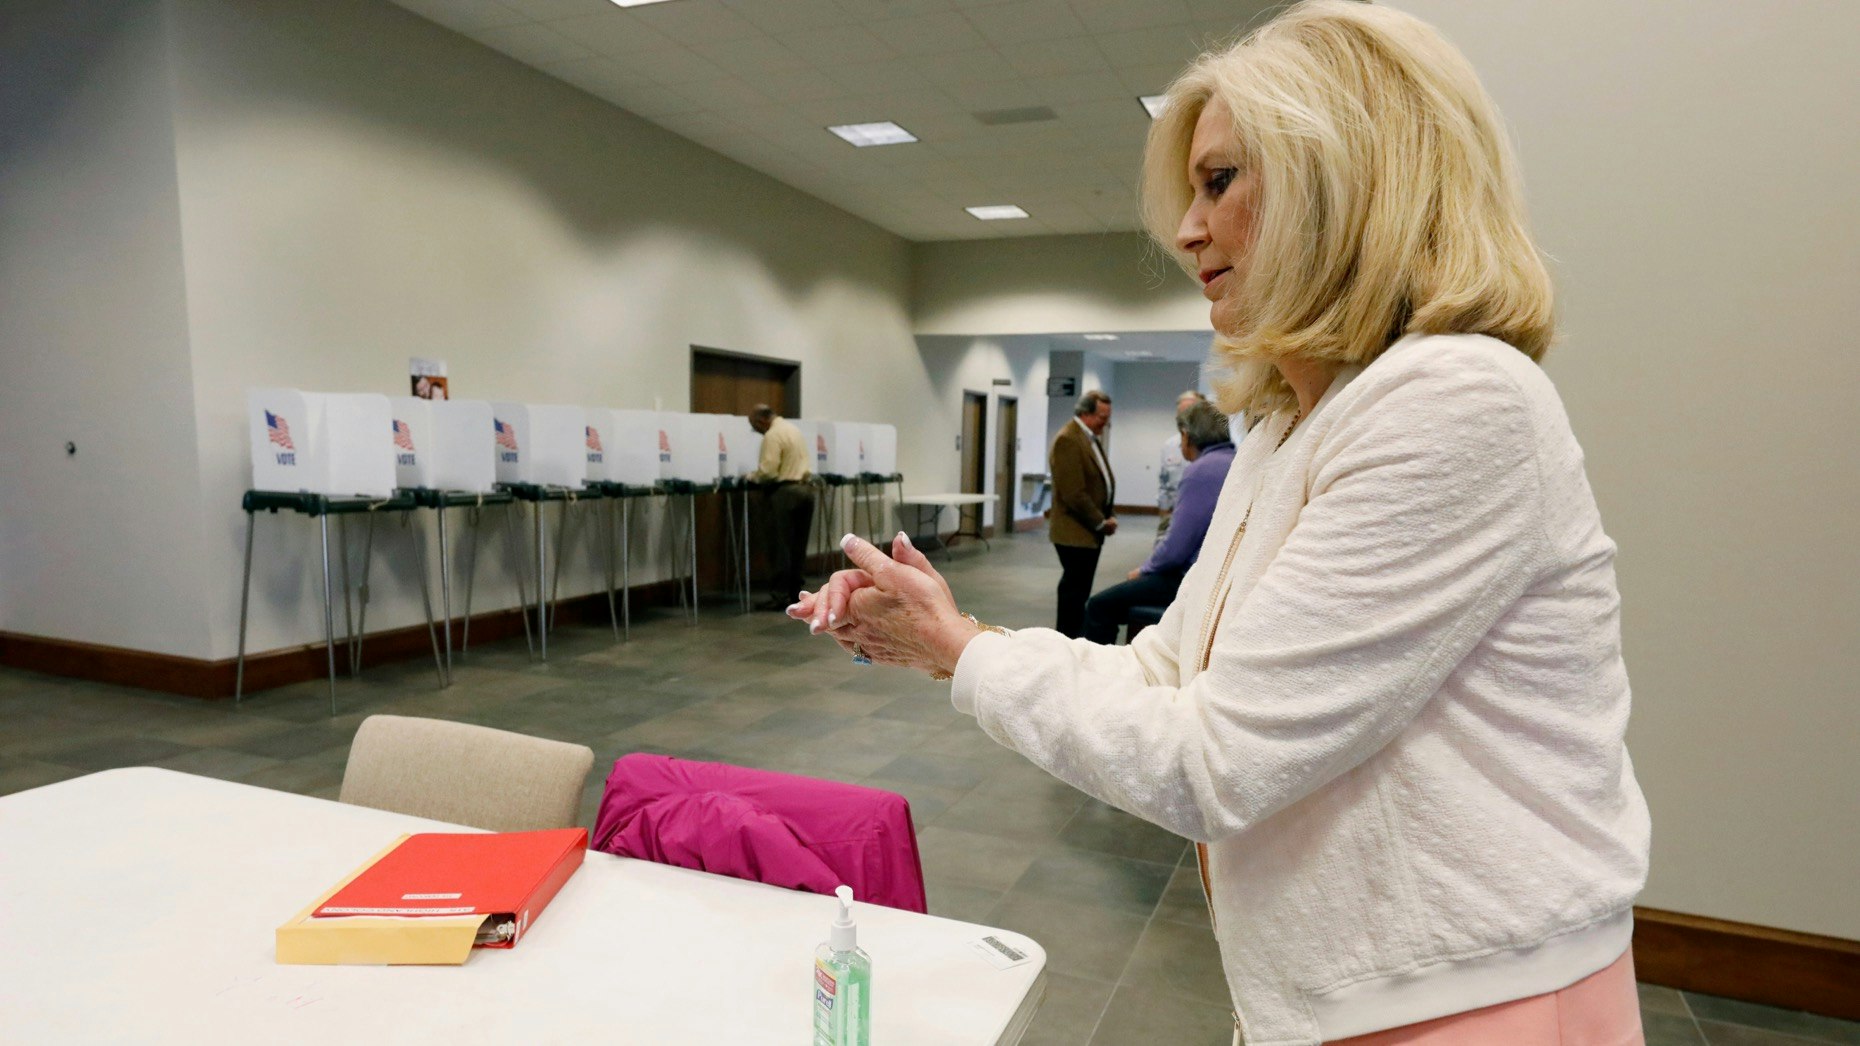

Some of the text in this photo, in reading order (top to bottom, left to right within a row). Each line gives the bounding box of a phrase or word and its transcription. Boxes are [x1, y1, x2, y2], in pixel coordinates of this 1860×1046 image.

[276, 453, 296, 466] VOTE
[397, 453, 416, 466] VOTE
[501, 452, 519, 463] VOTE
